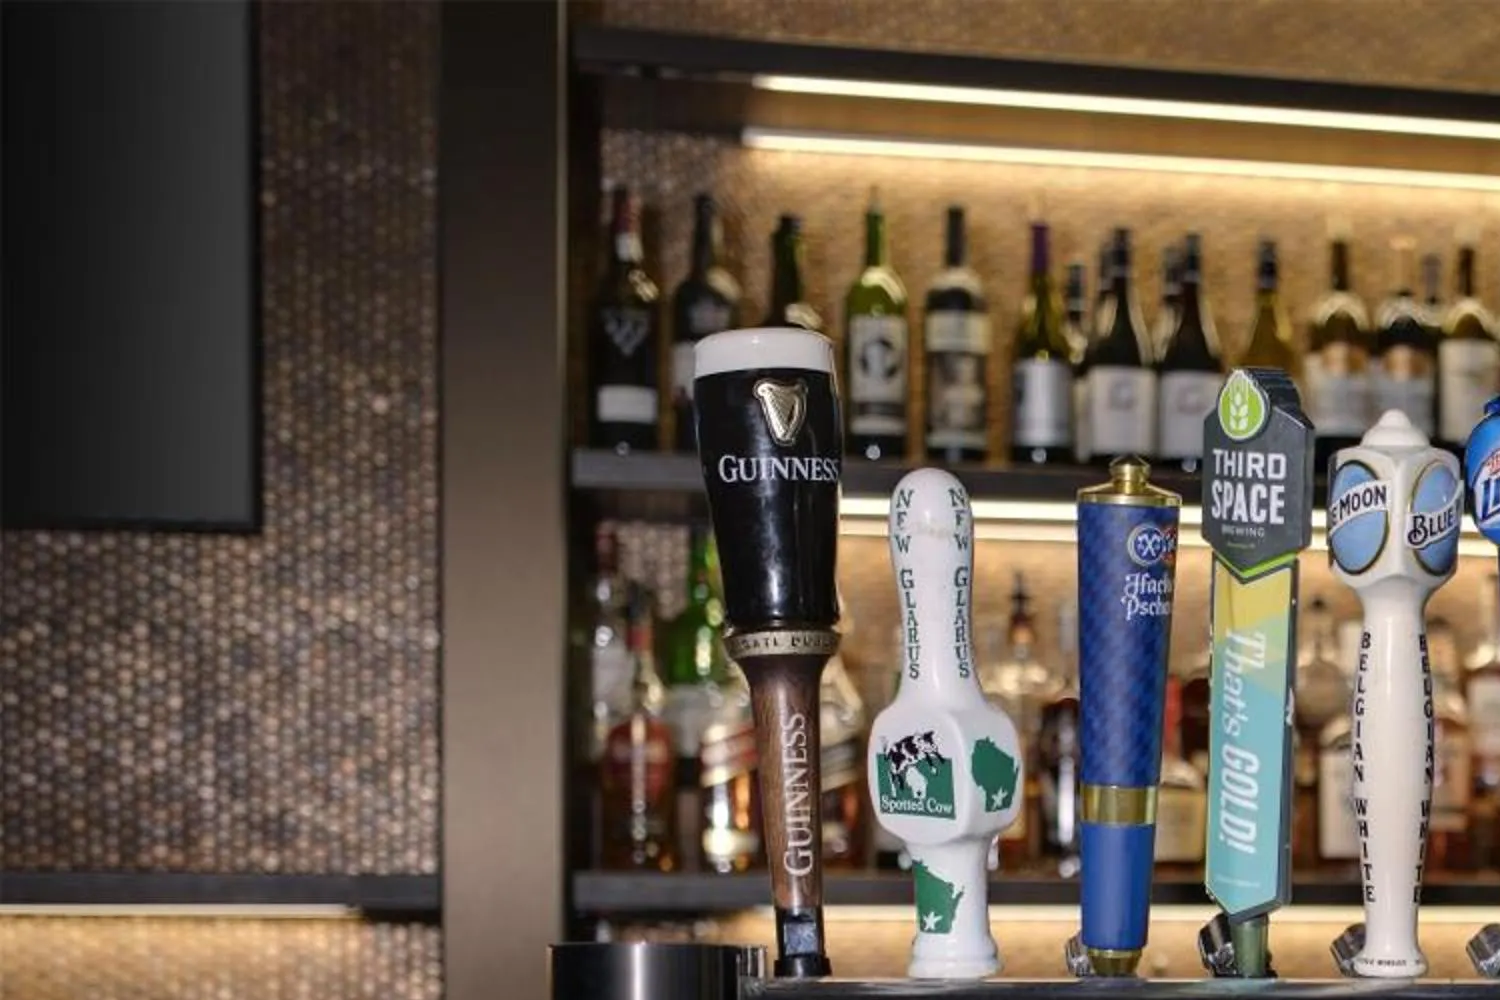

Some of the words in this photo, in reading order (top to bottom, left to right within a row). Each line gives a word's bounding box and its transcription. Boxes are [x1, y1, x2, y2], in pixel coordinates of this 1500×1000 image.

[718, 454, 839, 483] GUINNESS
[1212, 448, 1287, 480] THIRD
[1211, 479, 1286, 525] SPACE
[1339, 485, 1387, 521] MOON
[1407, 509, 1455, 546] BLUE
[899, 568, 921, 680] GLARUS
[953, 566, 971, 680] GLARUS
[1353, 631, 1372, 783] BELGIAN
[780, 712, 814, 878] GUINNESS
[881, 794, 924, 813] Spotted
[926, 797, 953, 814] Cow
[1218, 743, 1261, 855] GOLD!
[1355, 798, 1377, 903] WHITE
